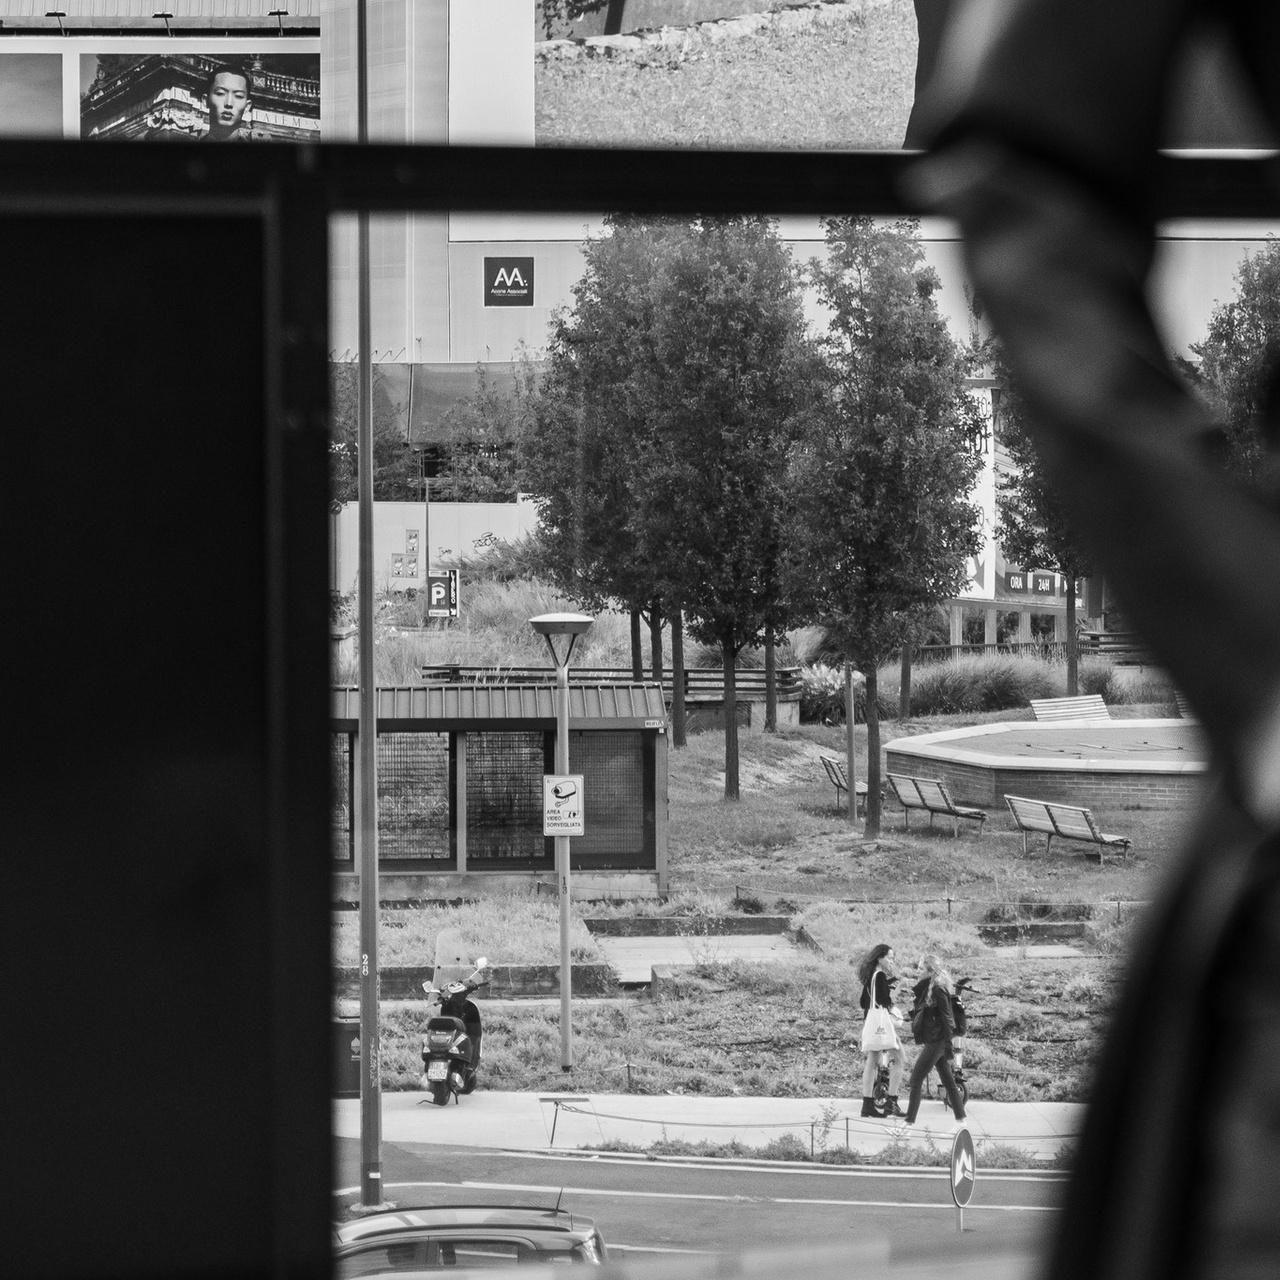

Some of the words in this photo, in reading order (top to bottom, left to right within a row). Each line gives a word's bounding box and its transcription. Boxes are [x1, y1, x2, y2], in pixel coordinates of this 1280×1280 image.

[1010, 575, 1023, 590] ORA
[1038, 578, 1050, 592] 24H
[431, 586, 446, 605] P
[362, 953, 369, 976] 28
